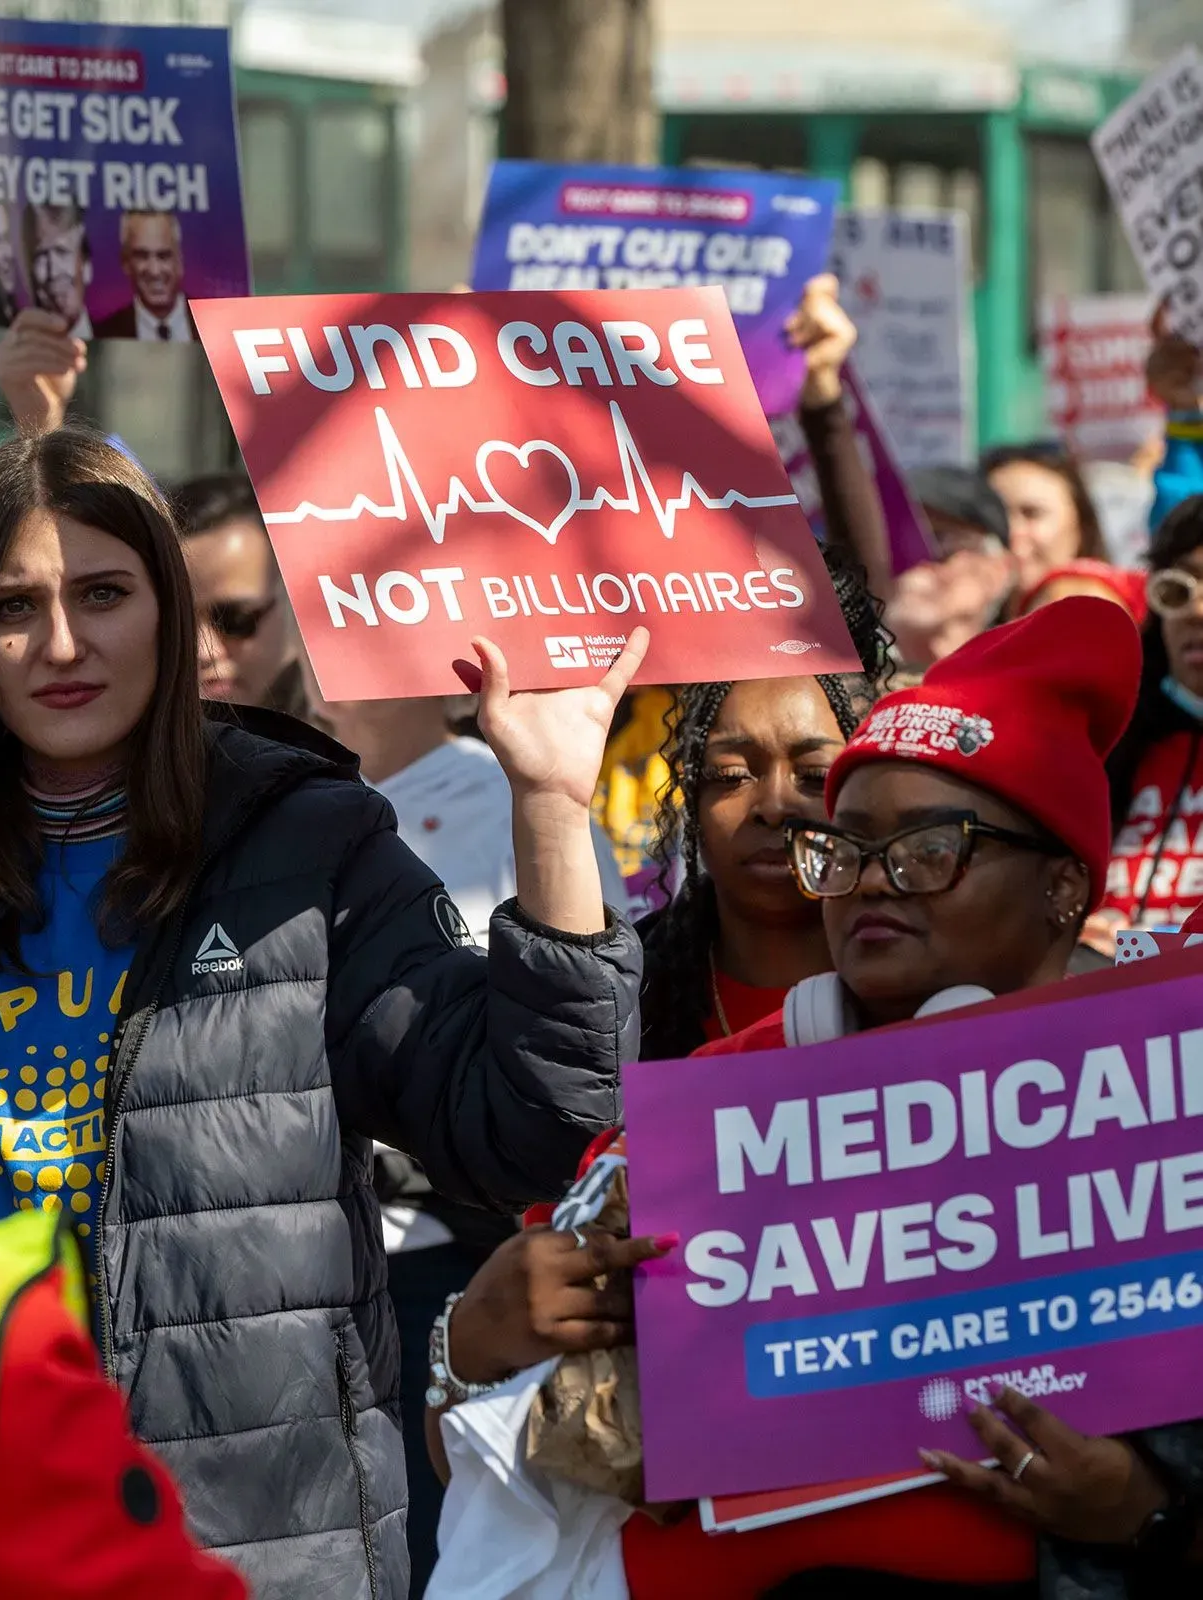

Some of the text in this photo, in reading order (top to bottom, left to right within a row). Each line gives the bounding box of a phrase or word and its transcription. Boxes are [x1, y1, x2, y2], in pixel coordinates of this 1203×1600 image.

[16, 56, 55, 79] CARE
[58, 59, 80, 80] TO
[11, 90, 77, 141] GET
[81, 94, 183, 145] SICK
[26, 156, 96, 208] GET
[103, 161, 209, 212] RICH
[506, 222, 792, 278] DON'T CUT OUR
[232, 318, 726, 395] FUND CARE
[317, 567, 805, 629] NOT BILLIONAIRES
[584, 634, 627, 645] National
[900, 728, 928, 743] OF
[929, 731, 959, 751] US
[191, 958, 244, 975] Reebok
[12, 1112, 108, 1153] ACTI
[684, 1193, 998, 1307] SAVES
[765, 1330, 878, 1377] TEXT
[890, 1308, 1009, 1360] CARE
[1019, 1295, 1078, 1338] TO
